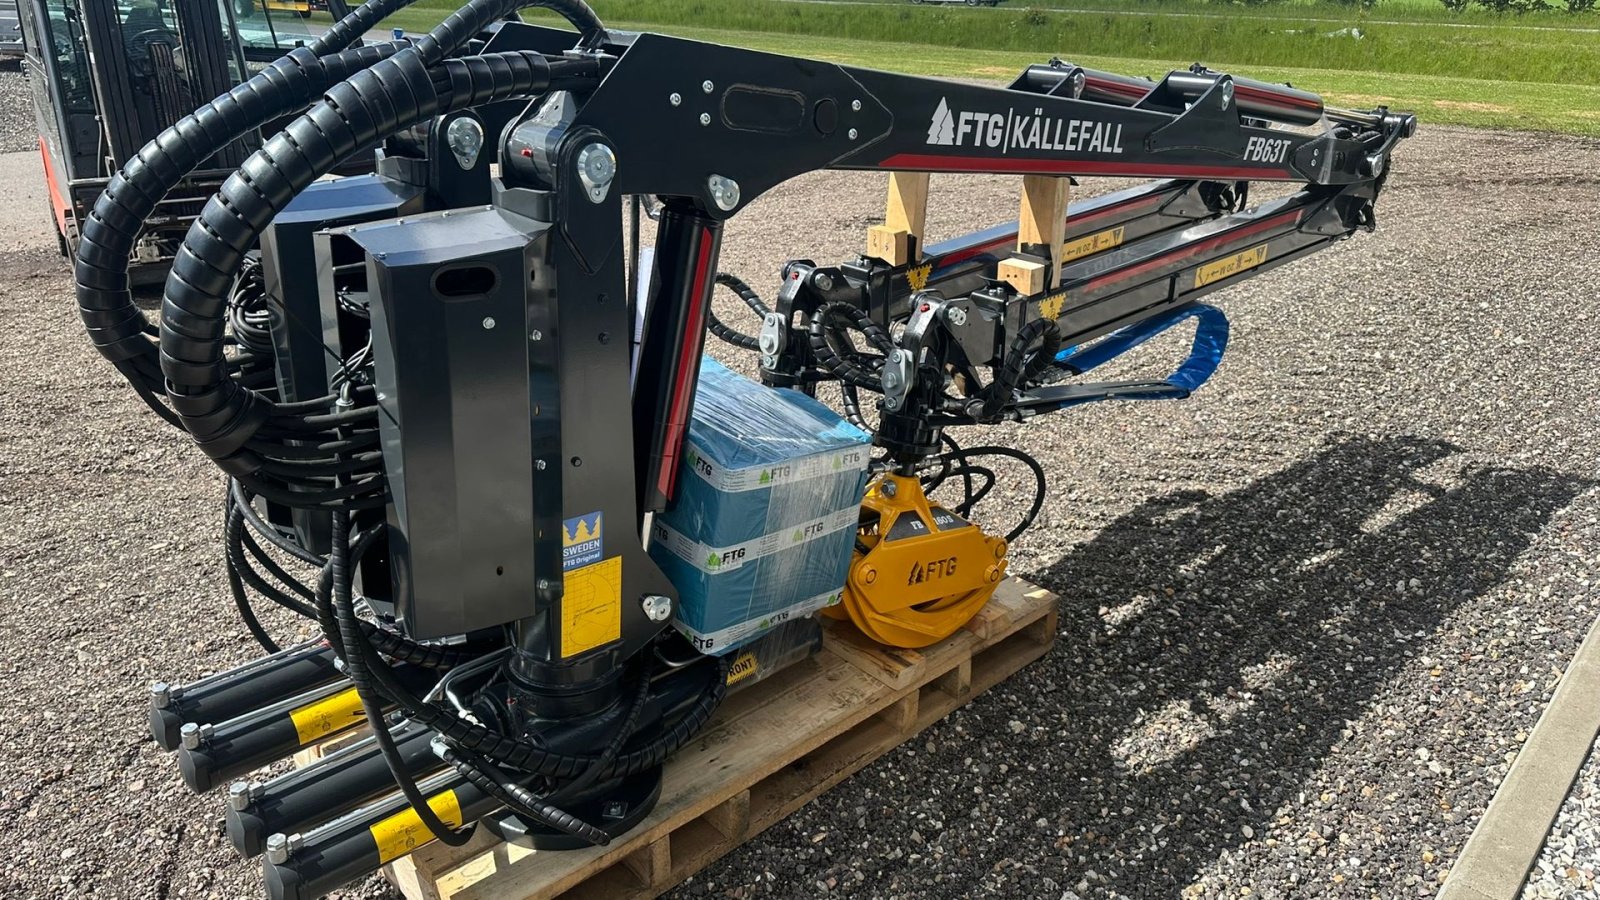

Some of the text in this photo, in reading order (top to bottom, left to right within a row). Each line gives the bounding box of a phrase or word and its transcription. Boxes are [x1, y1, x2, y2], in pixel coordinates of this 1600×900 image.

[955, 107, 1124, 154] FTG KÄLLEFALL
[1243, 136, 1292, 163] FB63T
[695, 456, 713, 476] FTG
[843, 452, 861, 465] FTG
[770, 465, 791, 480] FTG
[804, 522, 824, 537] FTG
[563, 539, 600, 557] SWEDEN
[722, 547, 746, 563] FTG
[563, 559, 576, 568] FTG
[576, 551, 600, 564] Original
[925, 556, 958, 582] FTG
[692, 635, 714, 650] FTG
[728, 658, 753, 677] RONT
